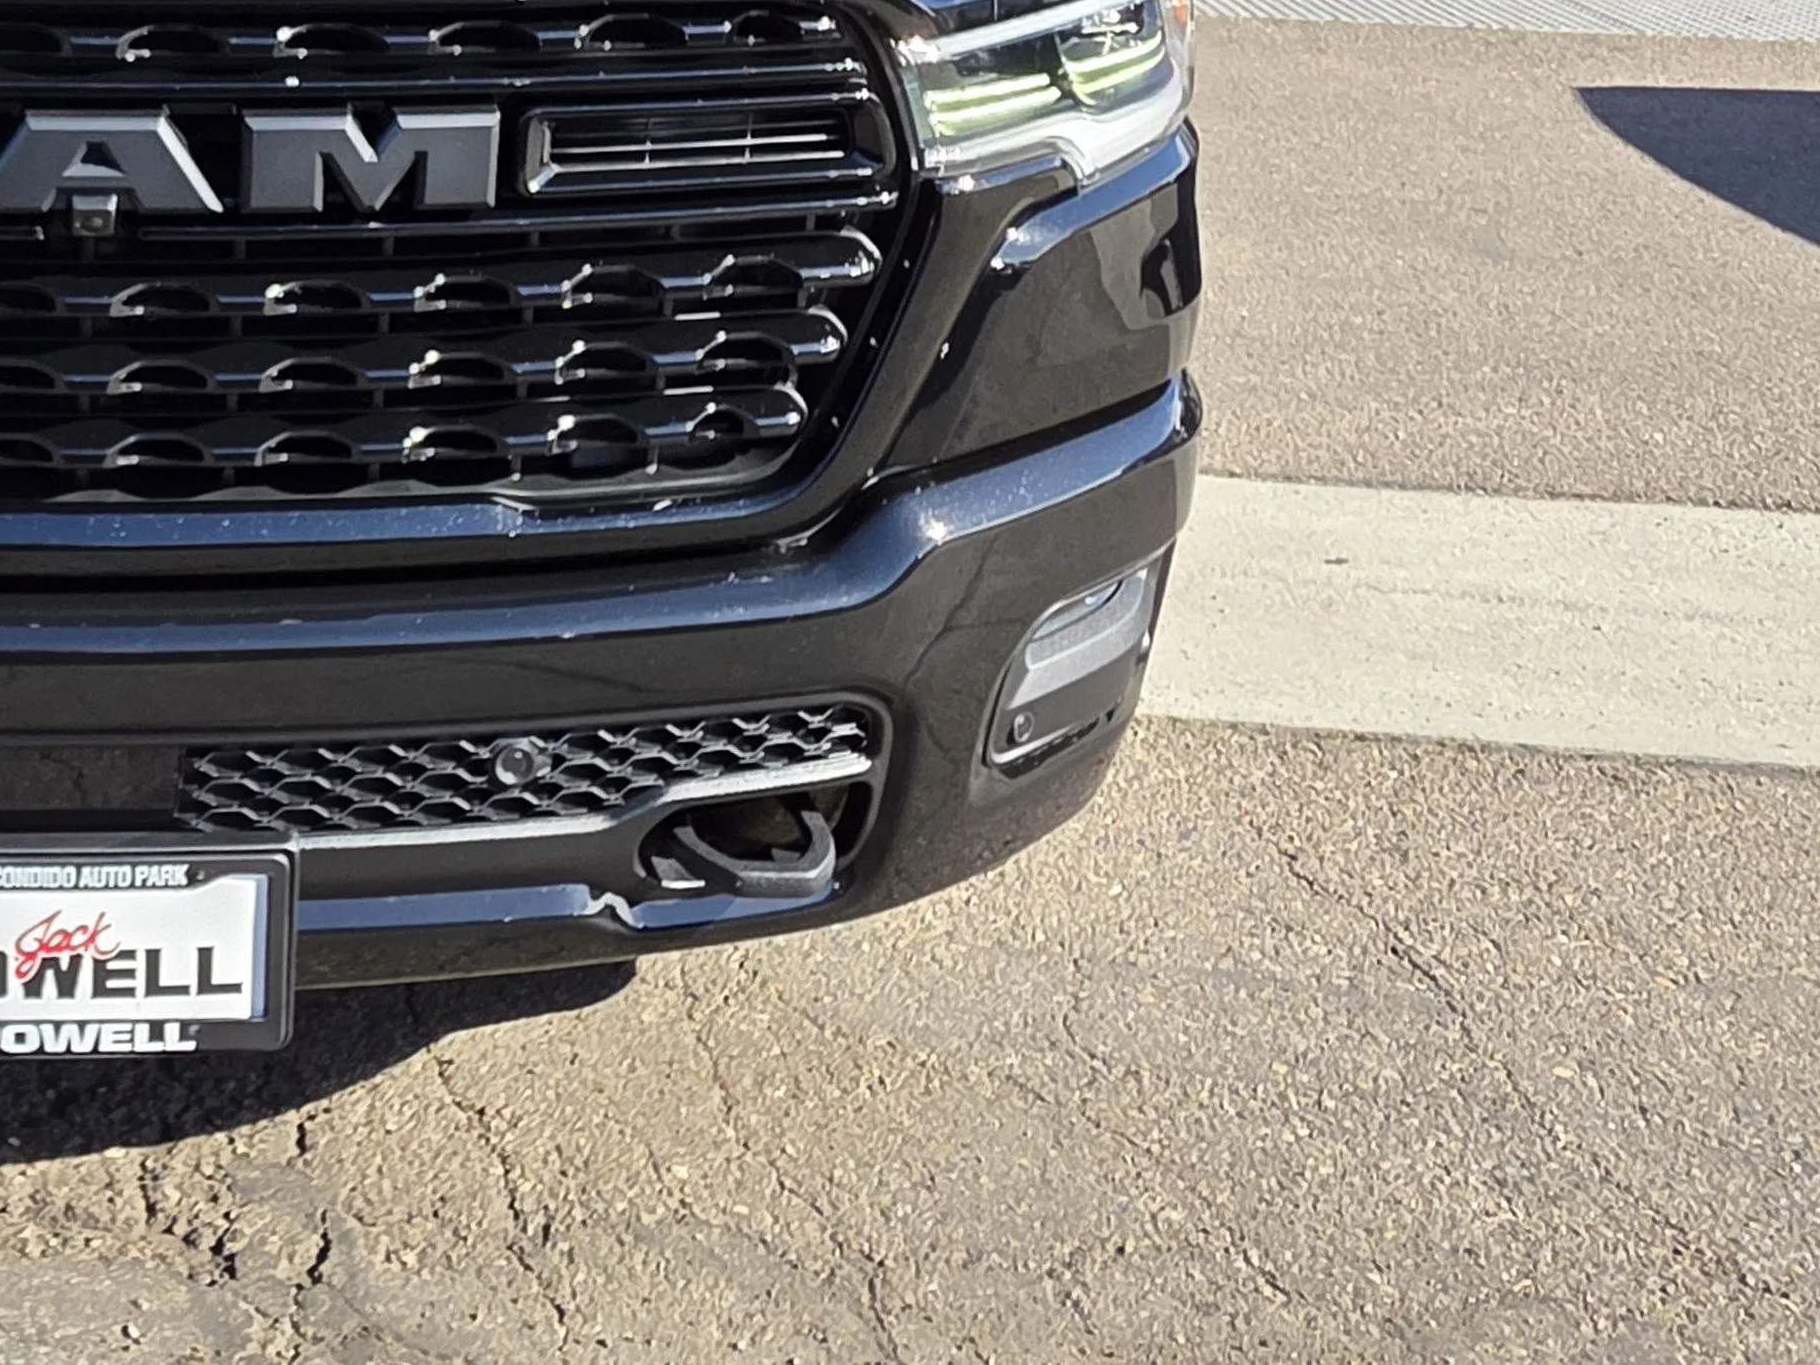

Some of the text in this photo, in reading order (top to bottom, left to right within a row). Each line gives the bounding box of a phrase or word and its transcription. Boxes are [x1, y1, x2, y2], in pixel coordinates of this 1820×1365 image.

[79, 865, 132, 888] AUTO
[134, 864, 189, 887] PARK
[14, 909, 122, 980] Jack
